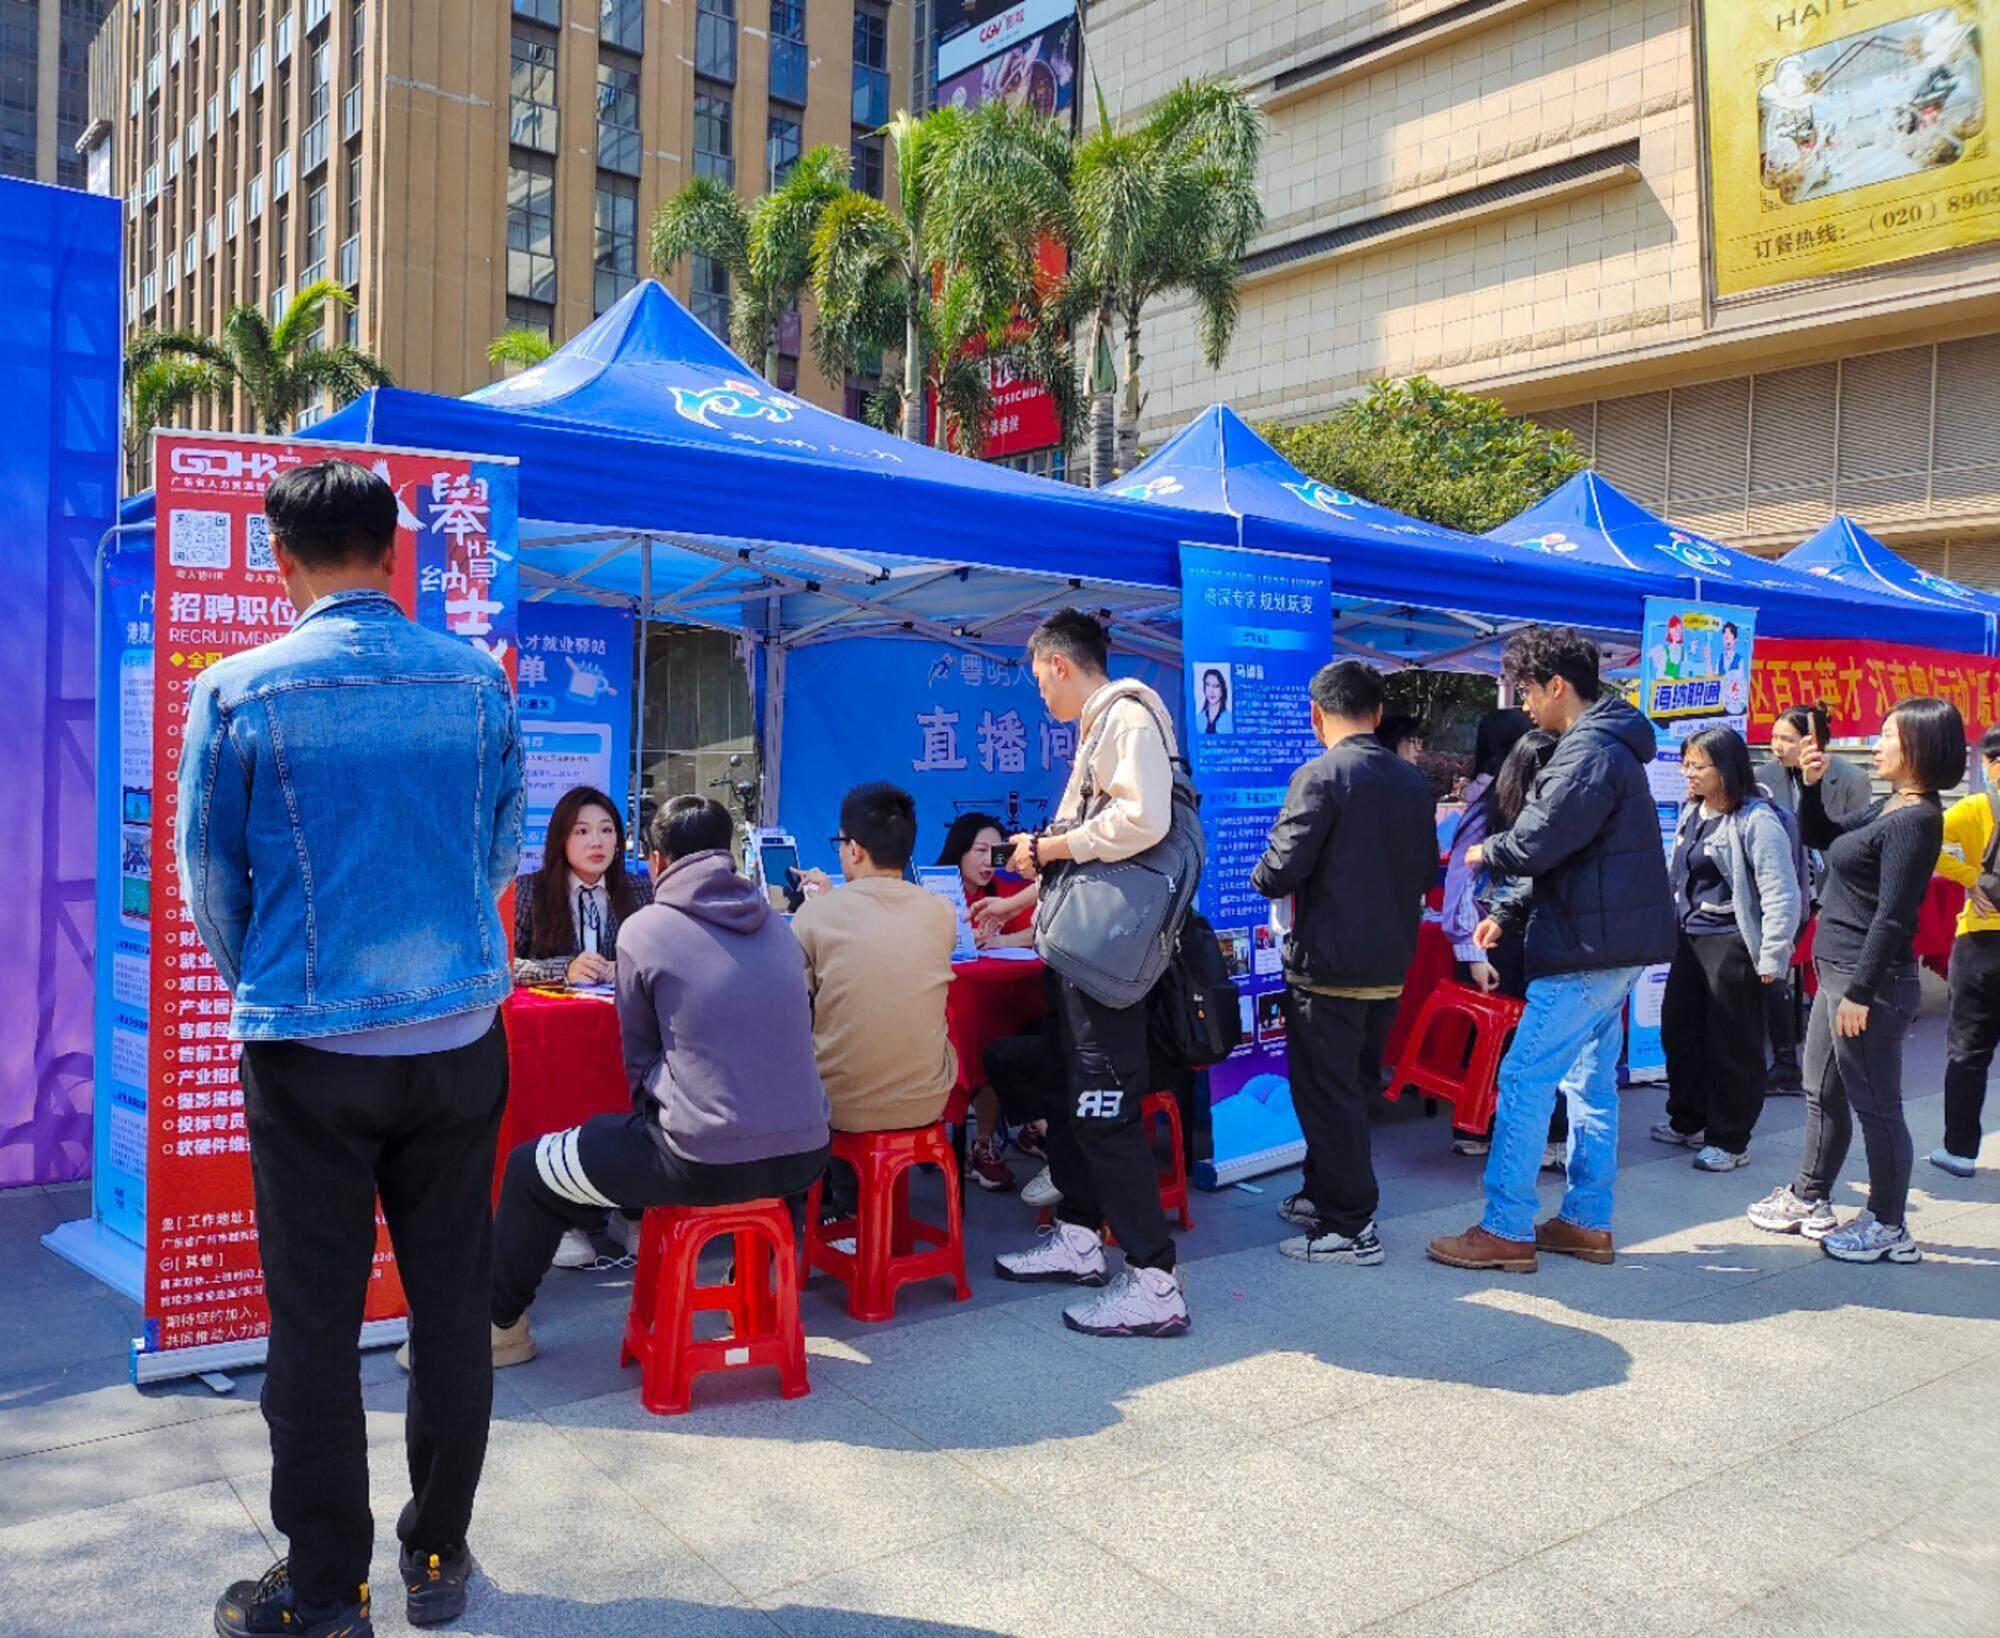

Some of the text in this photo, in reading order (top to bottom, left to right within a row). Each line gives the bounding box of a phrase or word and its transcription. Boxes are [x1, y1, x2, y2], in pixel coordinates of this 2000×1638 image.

[979, 21, 1002, 43] CGV
[170, 476, 272, 493] 广东省人力资源管
[170, 591, 298, 627] 招聘职位
[127, 621, 156, 644] 港澳
[519, 654, 549, 689] 单
[912, 704, 1080, 774] 直播间
[178, 952, 217, 970] 就业
[177, 997, 236, 1017] 产业园
[176, 1135, 251, 1157] 软硬件维
[166, 1321, 271, 1348] 共同推动人力资
